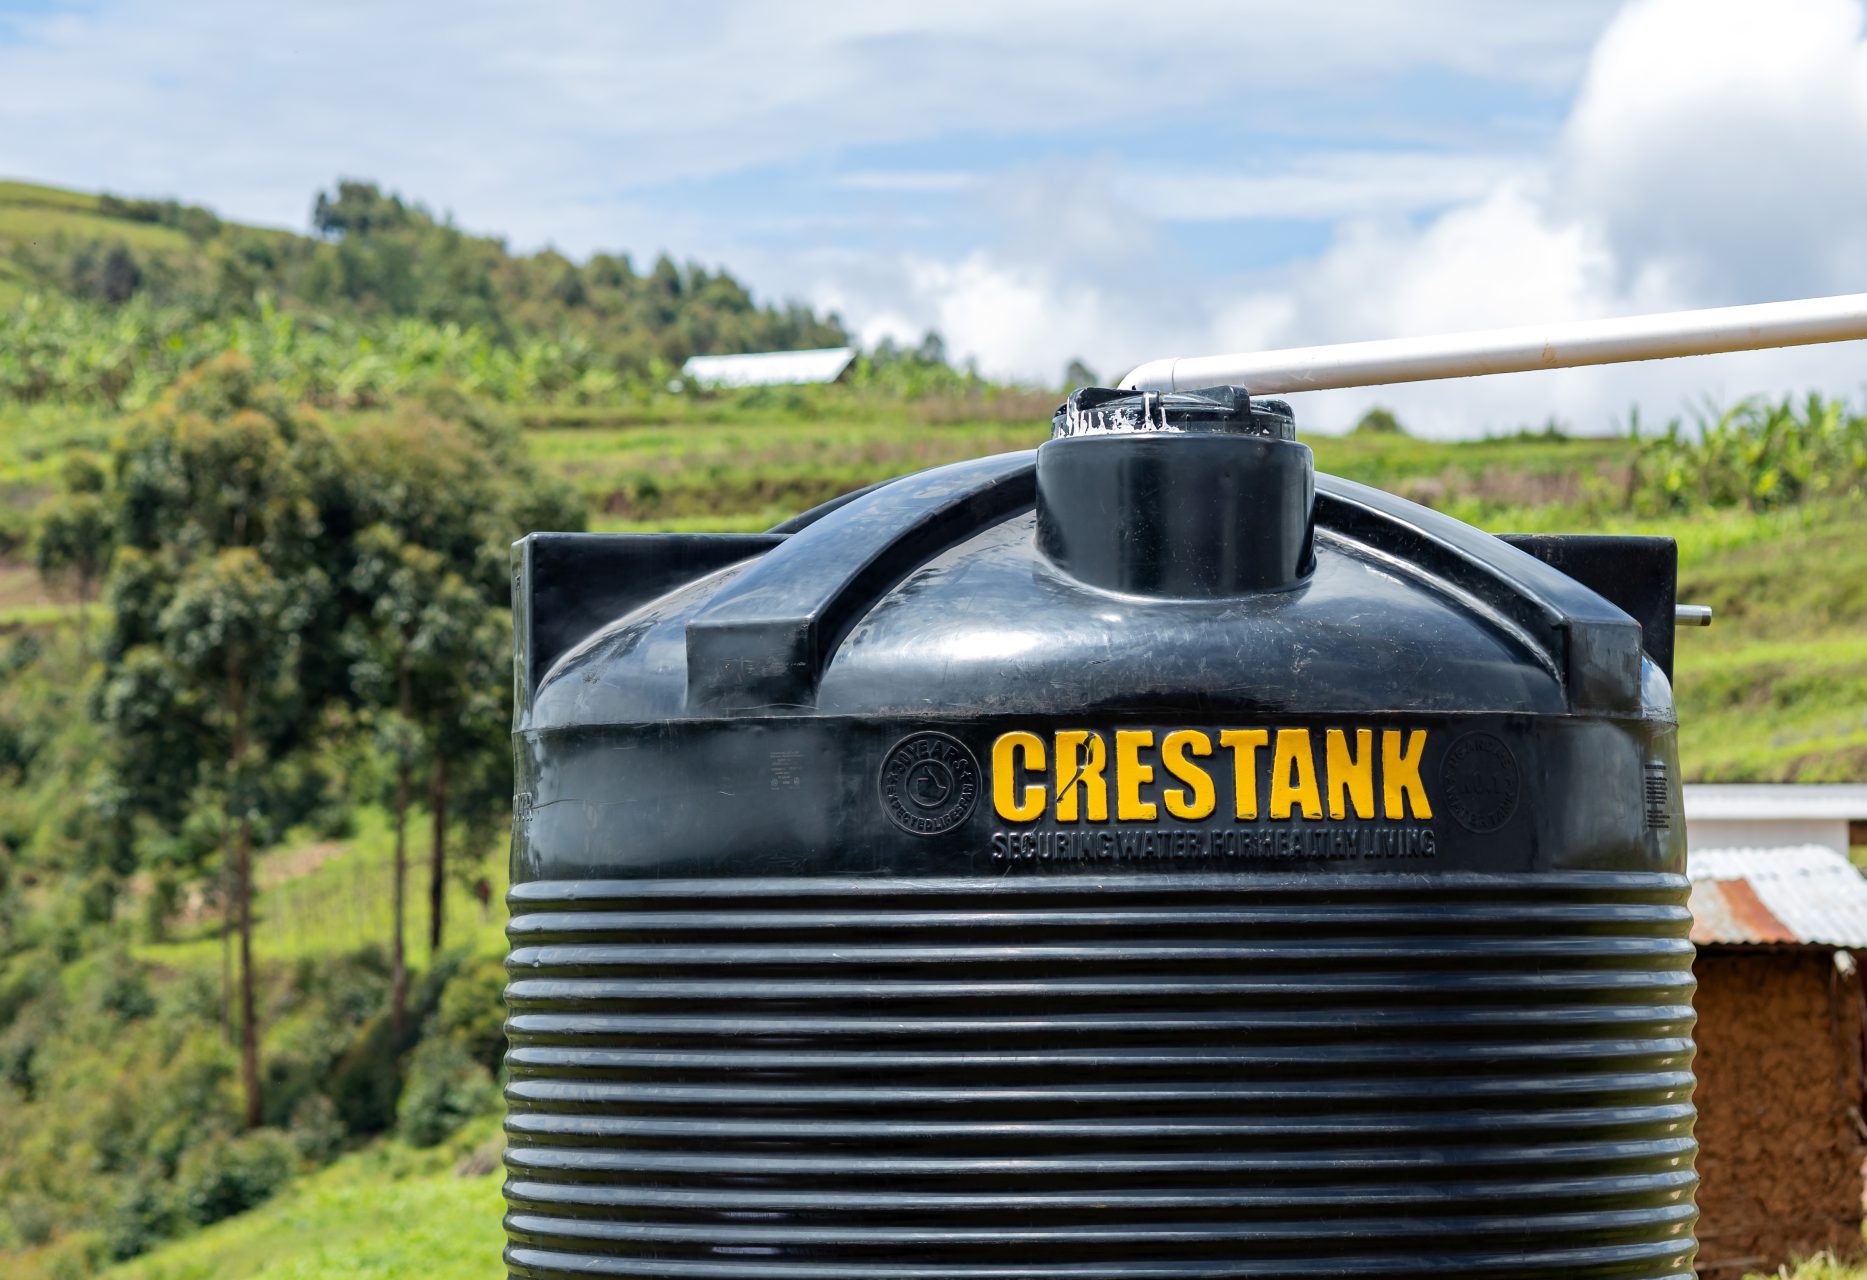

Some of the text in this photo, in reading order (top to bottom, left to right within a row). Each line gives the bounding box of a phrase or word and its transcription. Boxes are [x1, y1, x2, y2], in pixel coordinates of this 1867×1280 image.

[992, 729, 1433, 822] CRESTANK
[991, 831, 1112, 861] SECURING
[1211, 829, 1255, 857] FOR
[1257, 829, 1357, 857] HEALTHY
[1362, 829, 1436, 857] LIVING
